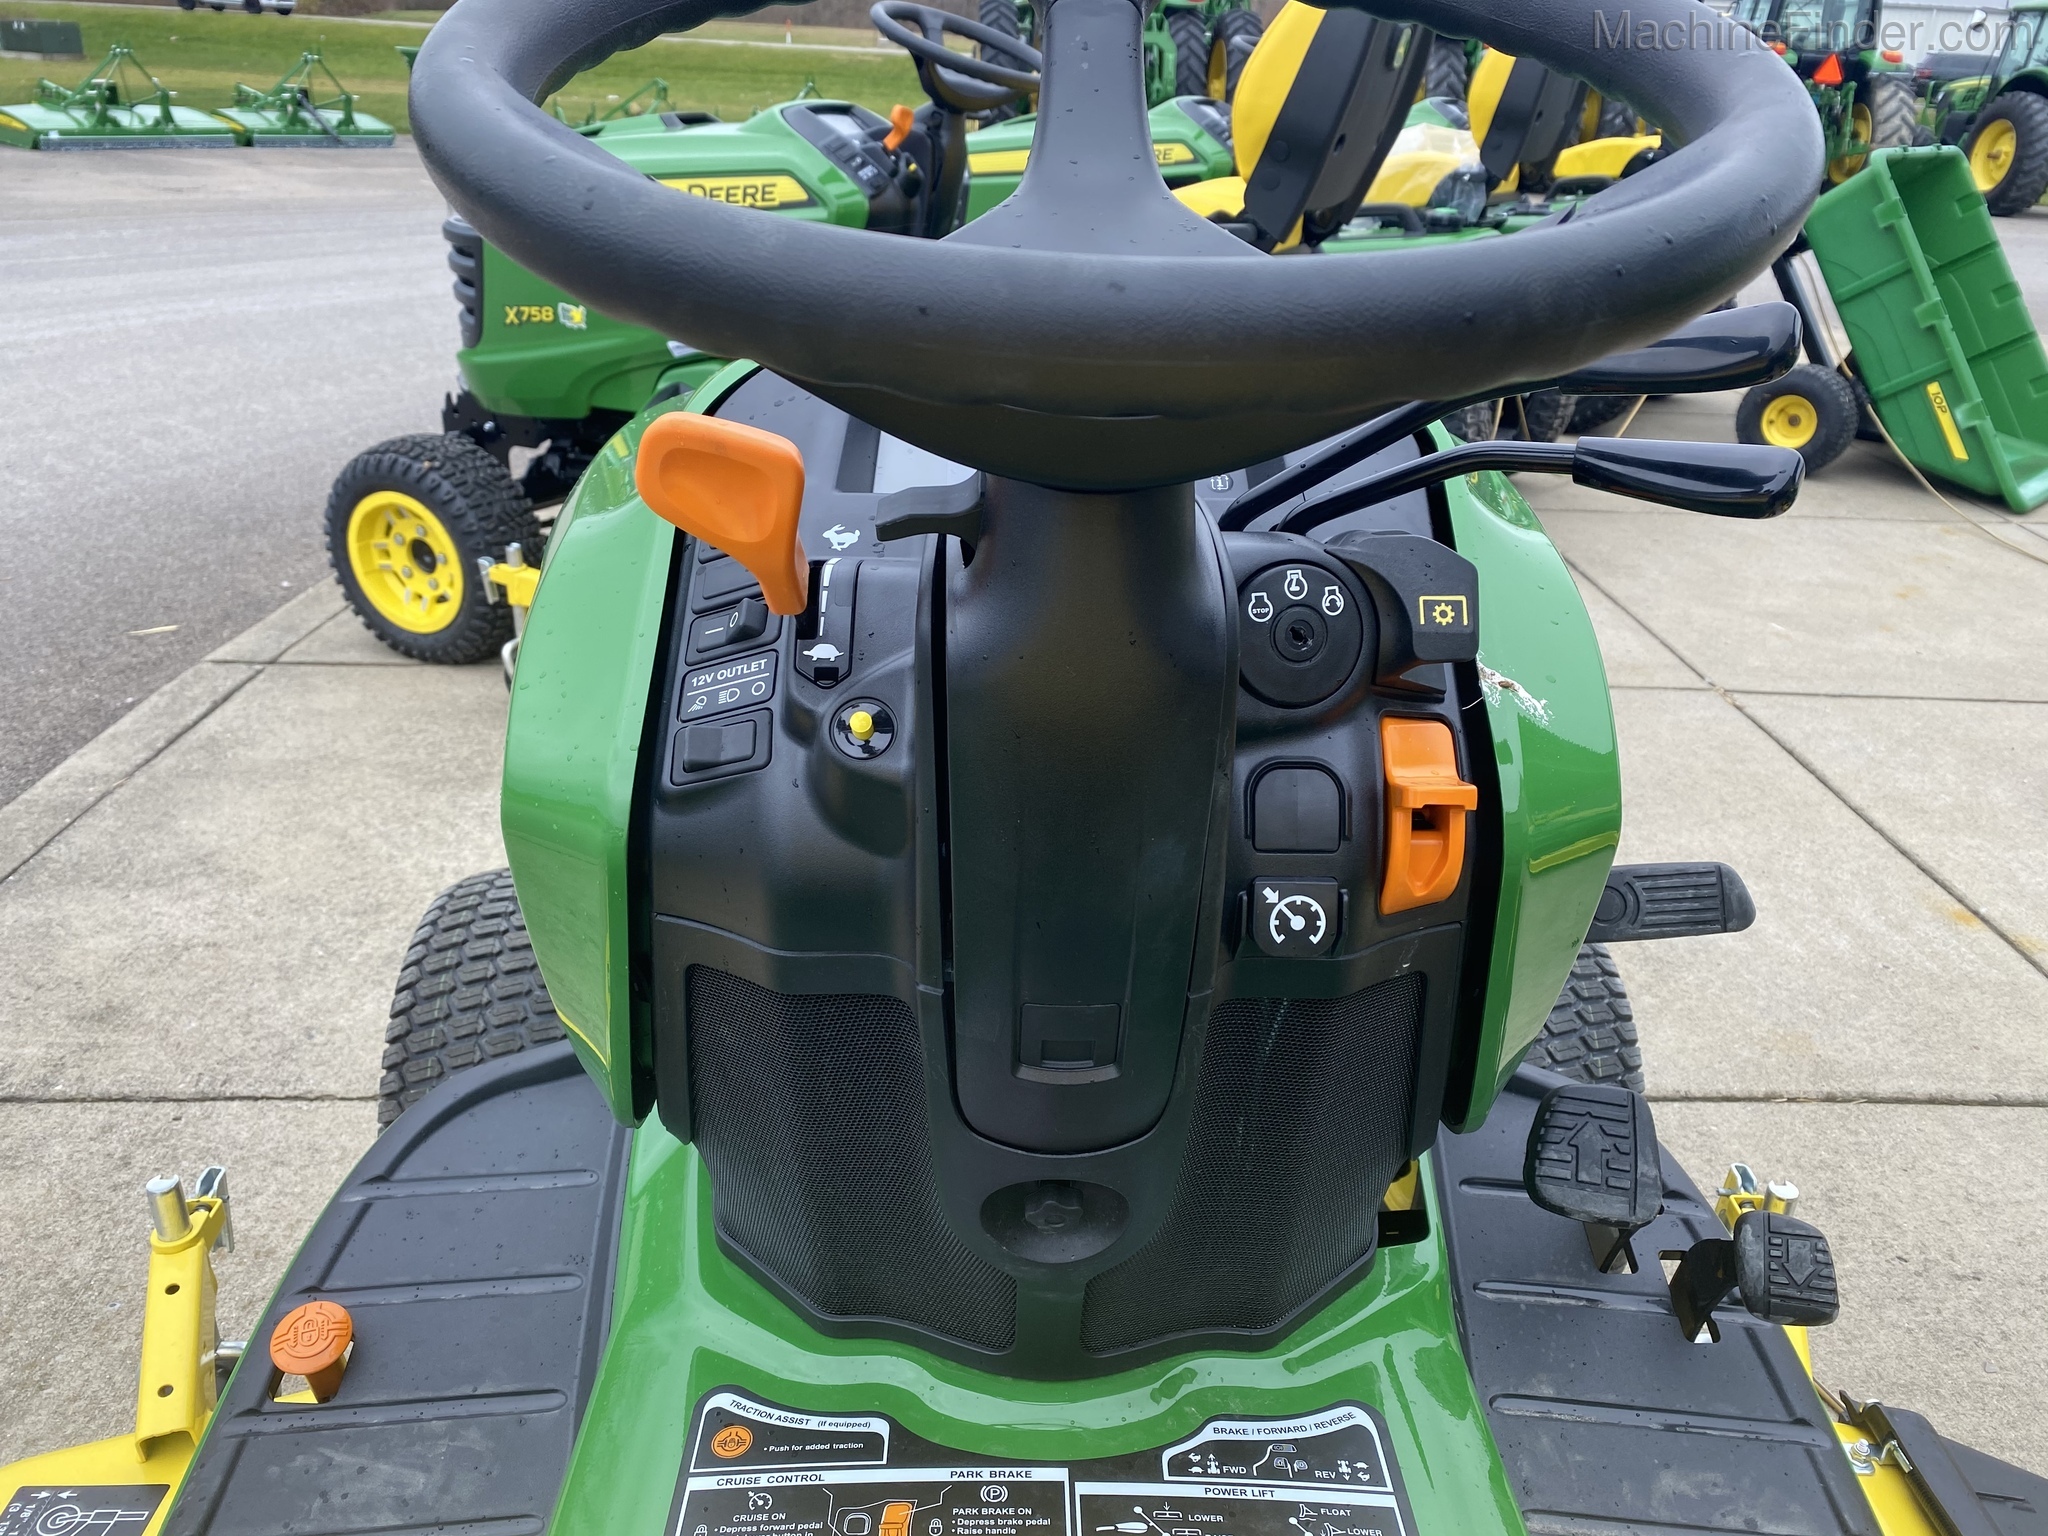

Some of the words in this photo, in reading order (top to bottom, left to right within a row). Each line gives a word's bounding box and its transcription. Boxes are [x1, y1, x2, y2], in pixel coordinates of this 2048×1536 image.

[688, 183, 777, 204] DEERE
[504, 305, 555, 325] X758
[691, 672, 714, 687] 12V
[716, 658, 768, 681] OUTLET
[729, 1399, 775, 1421] TRACTION
[775, 1414, 811, 1426] ASSIST
[828, 1421, 871, 1429] equipped)
[1213, 1426, 1249, 1436] BRAKE
[1257, 1424, 1308, 1436] FORWARD
[1313, 1411, 1357, 1430] REVERSE
[769, 1444, 790, 1452] Push
[791, 1444, 803, 1452] for
[805, 1443, 830, 1451] added
[832, 1442, 864, 1450] traction
[950, 1470, 983, 1479] PARK
[989, 1470, 1033, 1479] BRAKE
[1222, 1465, 1247, 1474] FWD
[1314, 1470, 1336, 1479] REV
[716, 1476, 761, 1487] CRUISE
[766, 1473, 826, 1484] CONTROL
[1204, 1487, 1248, 1497] POWER
[1251, 1489, 1276, 1498] LIFT
[952, 1507, 979, 1515] PARK
[981, 1507, 1015, 1515] BRAKE
[1017, 1507, 1032, 1515] ON
[1320, 1508, 1351, 1517] FLOAT
[732, 1513, 769, 1522] CRUISE
[771, 1512, 786, 1520] ON
[1188, 1514, 1224, 1522] LOWER
[719, 1525, 757, 1534] Depress
[759, 1522, 796, 1531] forward
[797, 1521, 824, 1531] pedal
[957, 1518, 995, 1527] Depress
[1025, 1518, 1051, 1527] pedal
[957, 1527, 983, 1535] Raise
[985, 1527, 1017, 1535] handle
[1347, 1527, 1383, 1536] LOWER
